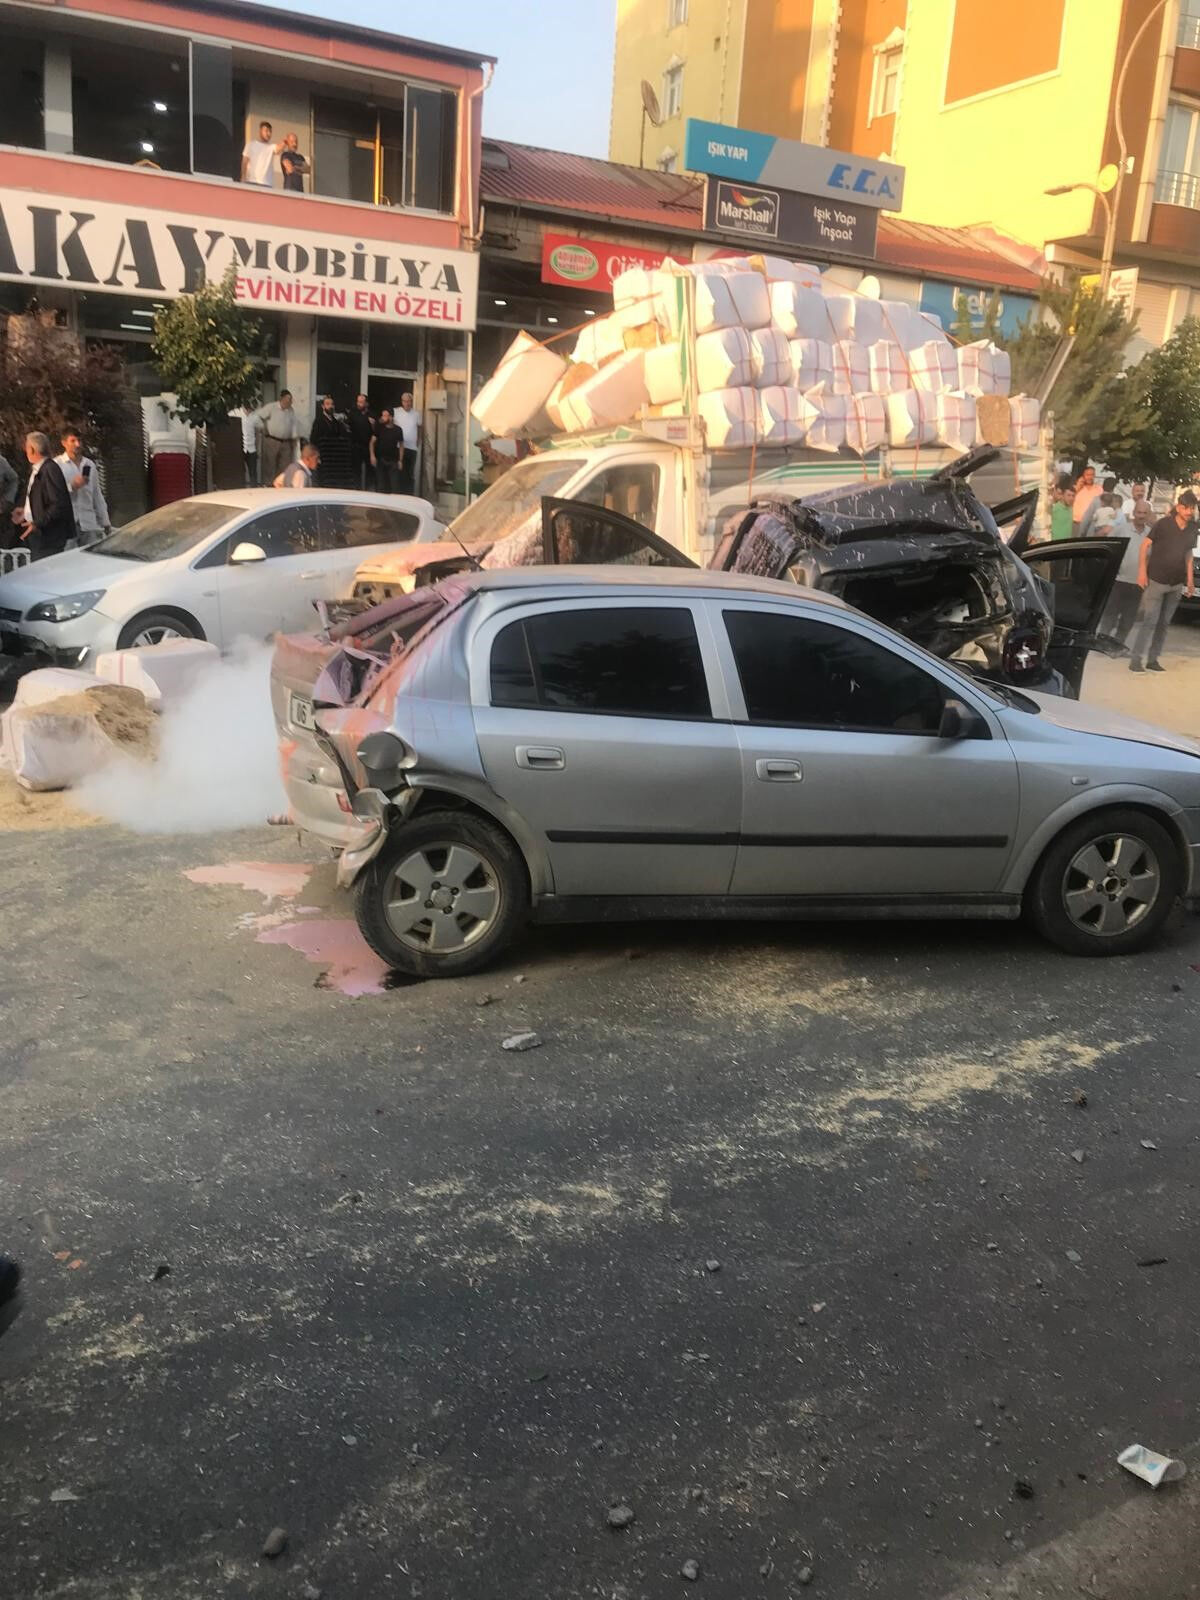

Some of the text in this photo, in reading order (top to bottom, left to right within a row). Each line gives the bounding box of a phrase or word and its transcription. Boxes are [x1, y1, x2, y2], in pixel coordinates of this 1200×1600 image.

[708, 141, 748, 162] IŞIK YAPI
[721, 201, 770, 224] Marshall
[813, 205, 856, 226] Işık Yapı
[820, 220, 853, 241] İnşaat
[229, 236, 462, 293] MOBİLYA
[234, 275, 462, 322] EVİNİZİN EN ÖZELİ
